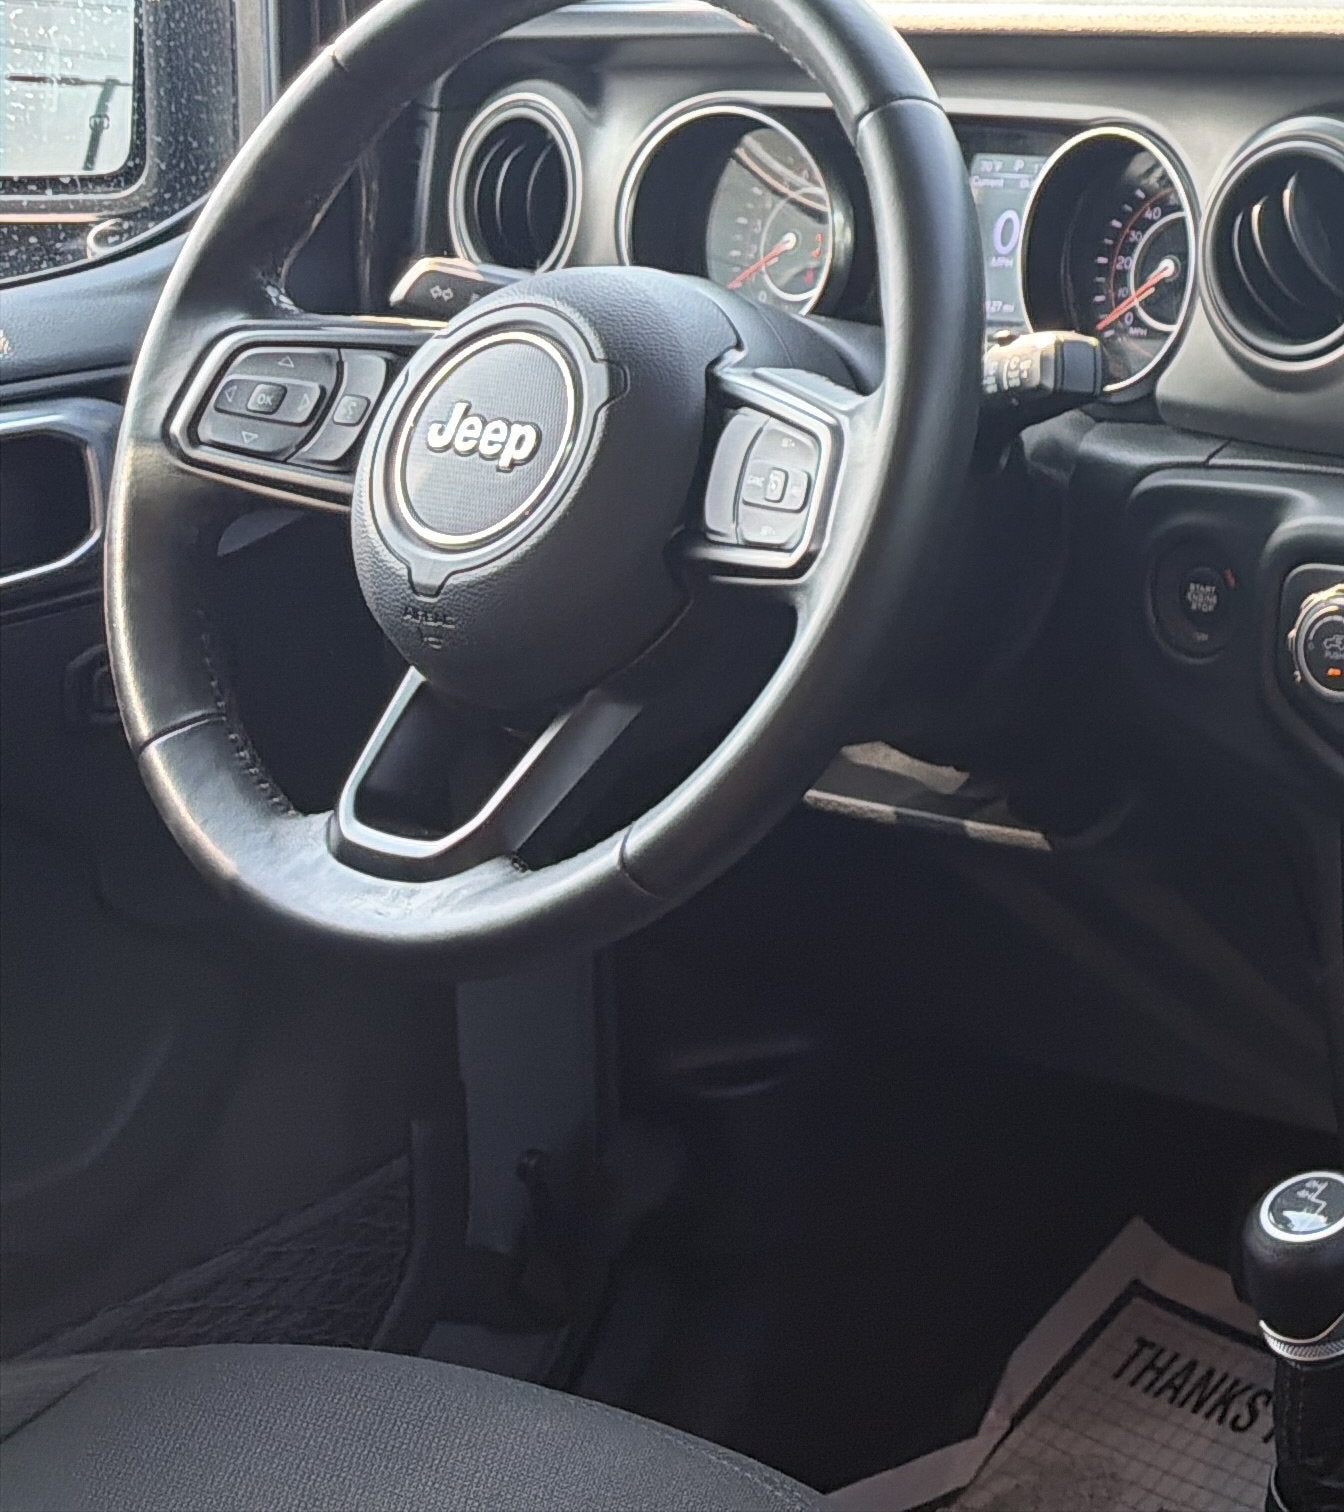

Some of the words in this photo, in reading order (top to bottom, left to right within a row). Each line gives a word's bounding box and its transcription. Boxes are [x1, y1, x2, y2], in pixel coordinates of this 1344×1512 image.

[1144, 206, 1162, 220] 40
[992, 209, 1021, 255] 0
[1129, 230, 1144, 243] 30
[1115, 256, 1132, 270] 20
[1124, 311, 1134, 326] 0
[1128, 325, 1148, 337] MPH
[257, 392, 274, 406] OK
[426, 399, 542, 473] Jeep
[1323, 648, 1344, 660] PUSH
[1112, 1336, 1273, 1433] THANKS
